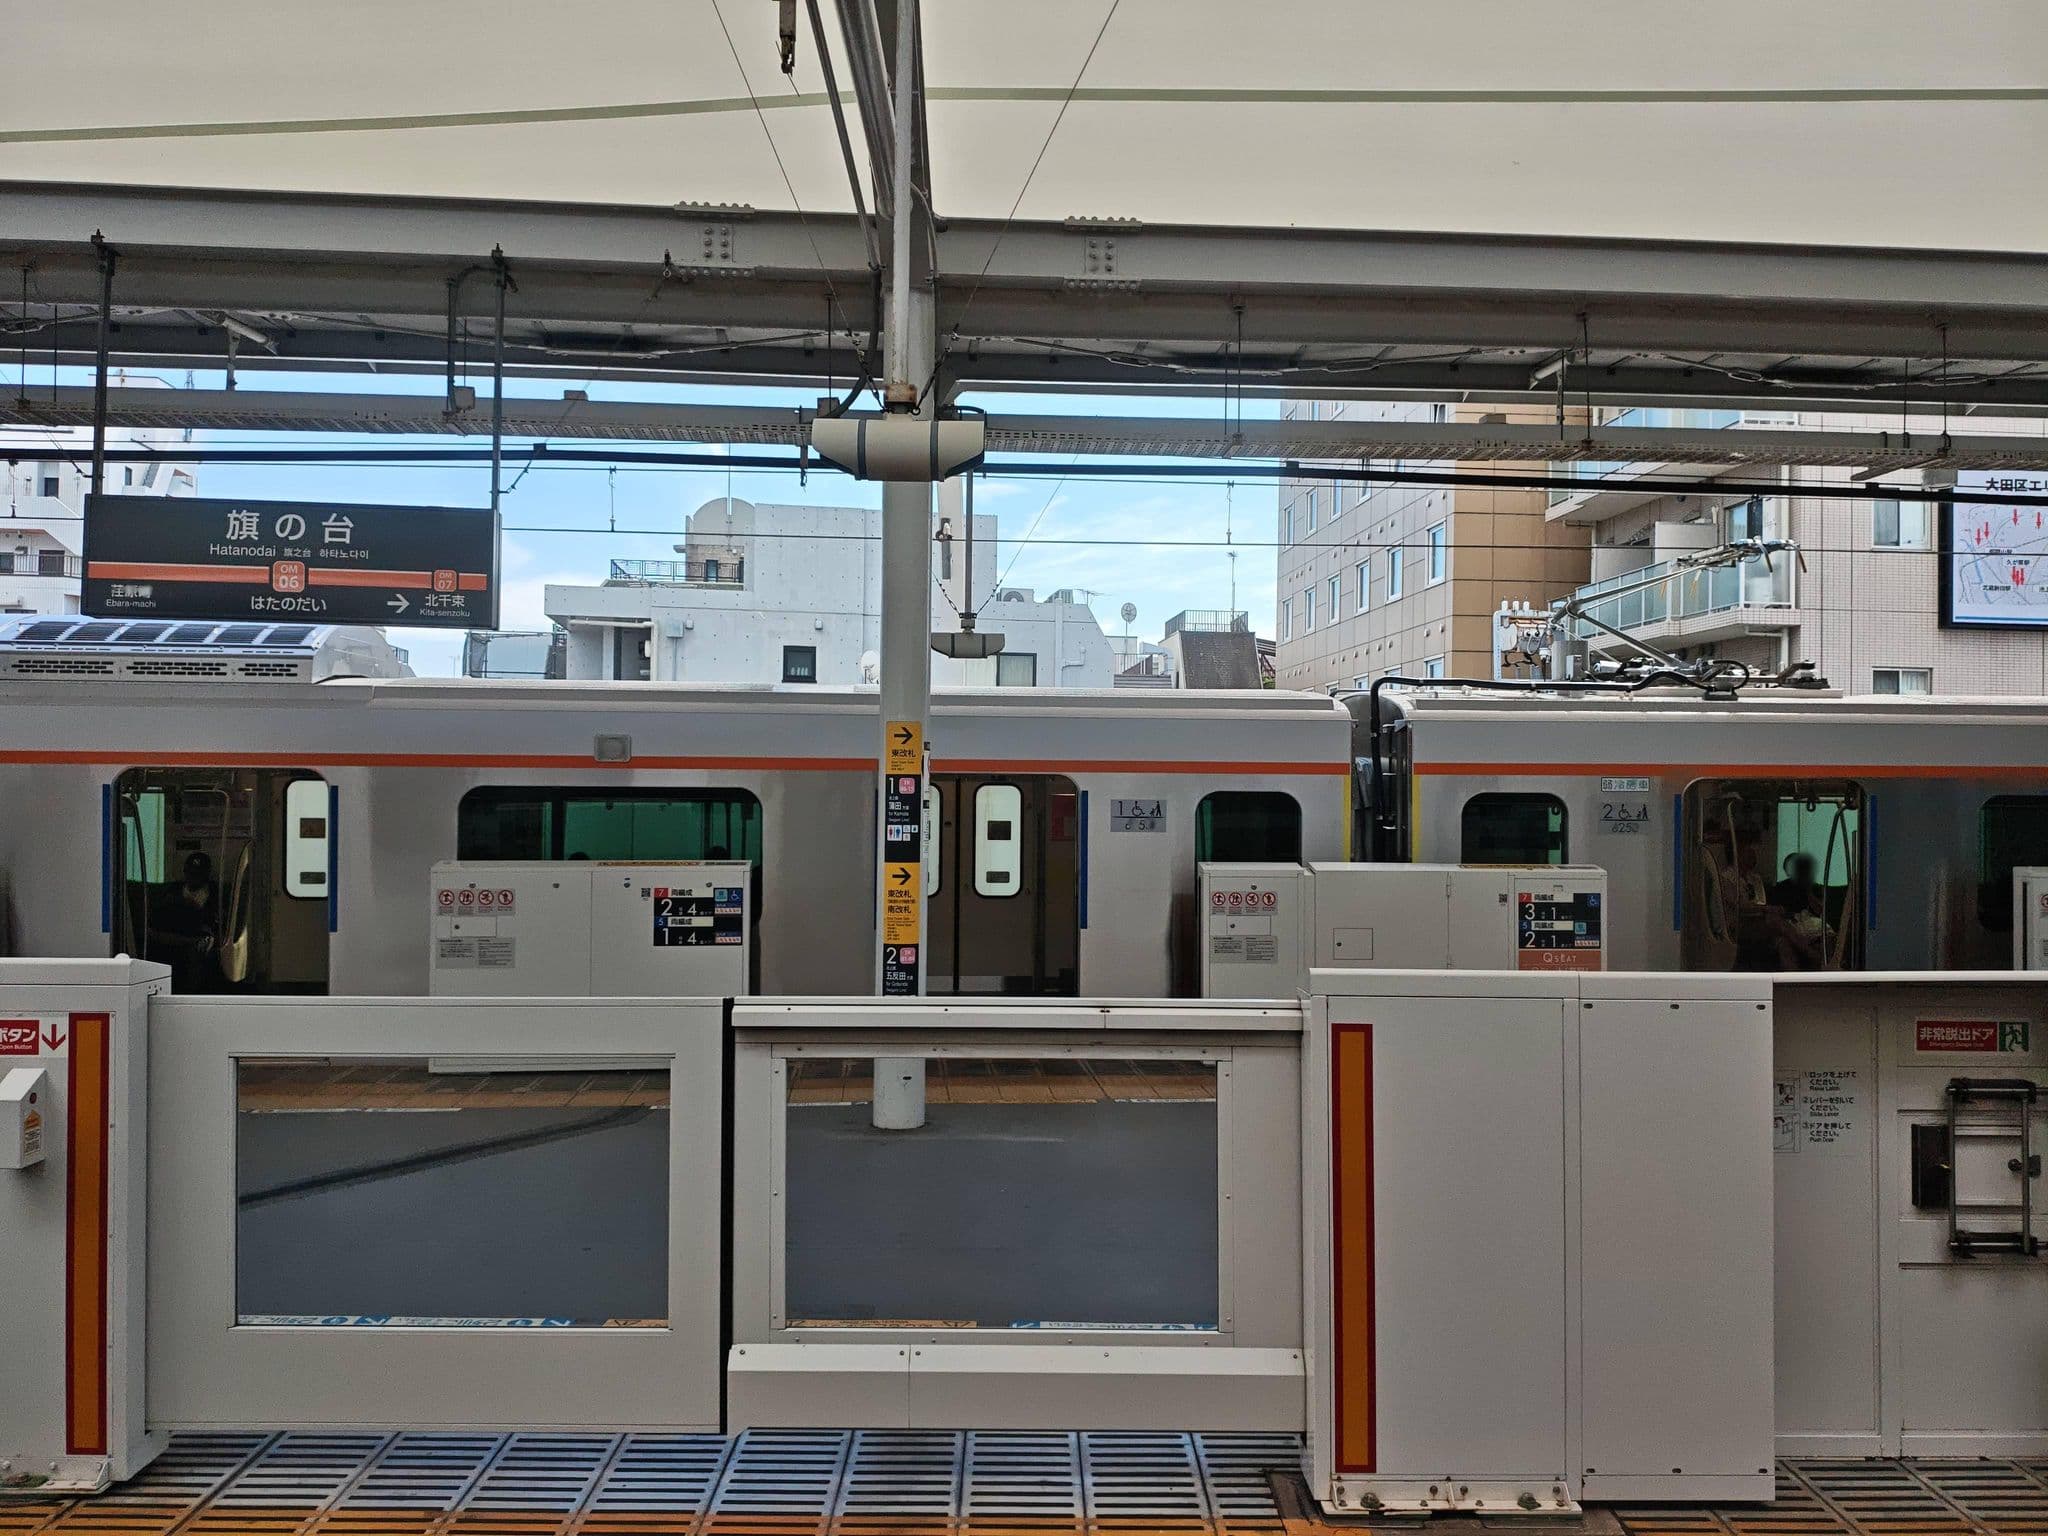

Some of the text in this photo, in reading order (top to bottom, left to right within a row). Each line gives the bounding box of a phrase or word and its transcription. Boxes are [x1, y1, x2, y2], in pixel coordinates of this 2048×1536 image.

[226, 509, 354, 545] 旗の台
[209, 543, 276, 557] Hatanodai
[319, 548, 369, 559] 하타노다이
[280, 565, 298, 574] OM
[278, 575, 299, 589] 06
[438, 580, 453, 590] 07
[106, 598, 156, 608] Ebara-machi
[250, 596, 327, 612] はたのだい
[419, 608, 470, 617] Kita-senzoku
[891, 749, 916, 758] 東改札
[889, 777, 894, 794] 1
[1118, 801, 1123, 816] 1
[1603, 803, 1613, 819] 2
[887, 889, 912, 898] 東改札
[661, 898, 672, 916] 2
[687, 903, 697, 915] 4
[887, 905, 912, 914] 南改札
[1524, 903, 1535, 920] 3
[1551, 907, 1556, 920] 1
[662, 928, 669, 944] 1
[687, 932, 697, 945] 4
[1525, 931, 1536, 948] 2
[1551, 935, 1556, 948] 1
[886, 947, 897, 964] 2
